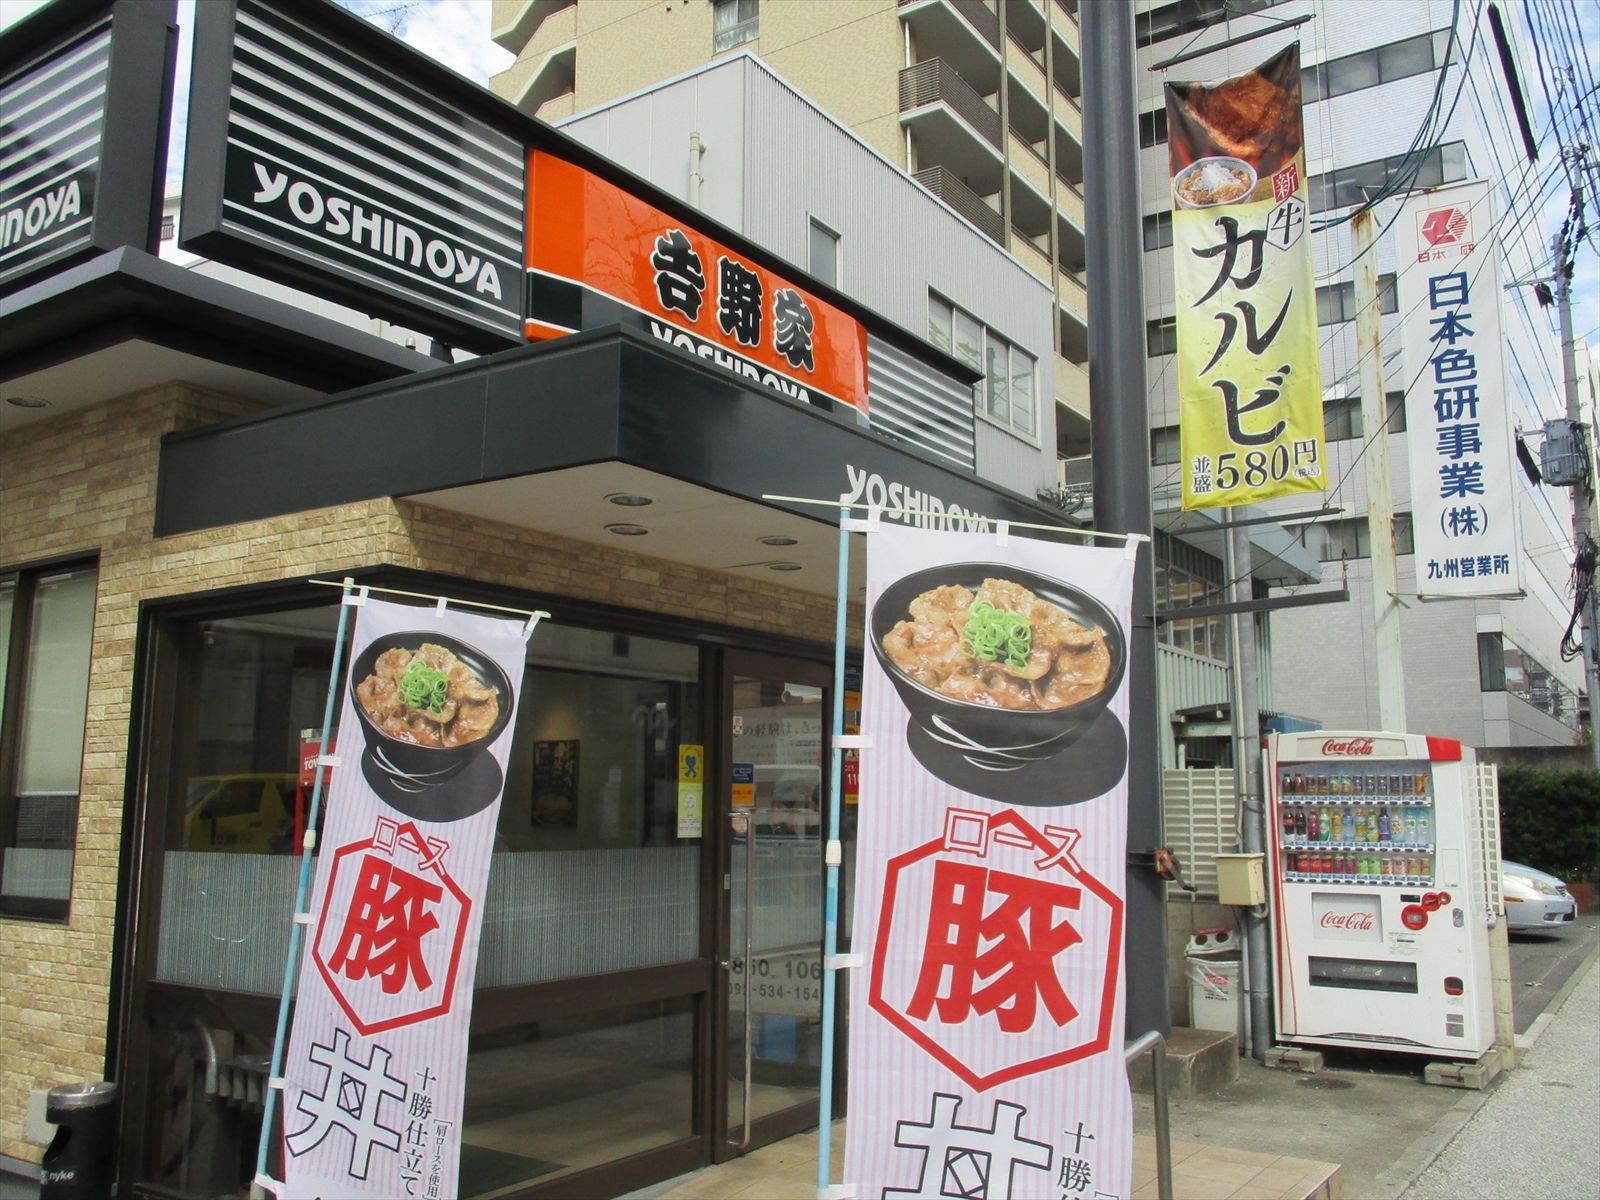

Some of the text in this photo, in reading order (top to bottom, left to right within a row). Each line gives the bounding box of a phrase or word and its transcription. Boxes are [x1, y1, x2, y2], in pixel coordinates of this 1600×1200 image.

[253, 162, 502, 300] YOSHINOYA
[1276, 168, 1297, 199] 新
[1190, 216, 1294, 446] カルビ
[1192, 456, 1212, 493] 並盛
[1427, 554, 1510, 580] 九州営業所
[327, 854, 444, 995] 豚
[904, 859, 1084, 1034] 豚
[285, 1027, 408, 1181] 丼
[400, 1066, 437, 1196] 十勝仕立て
[1057, 1122, 1096, 1200] 十勝
